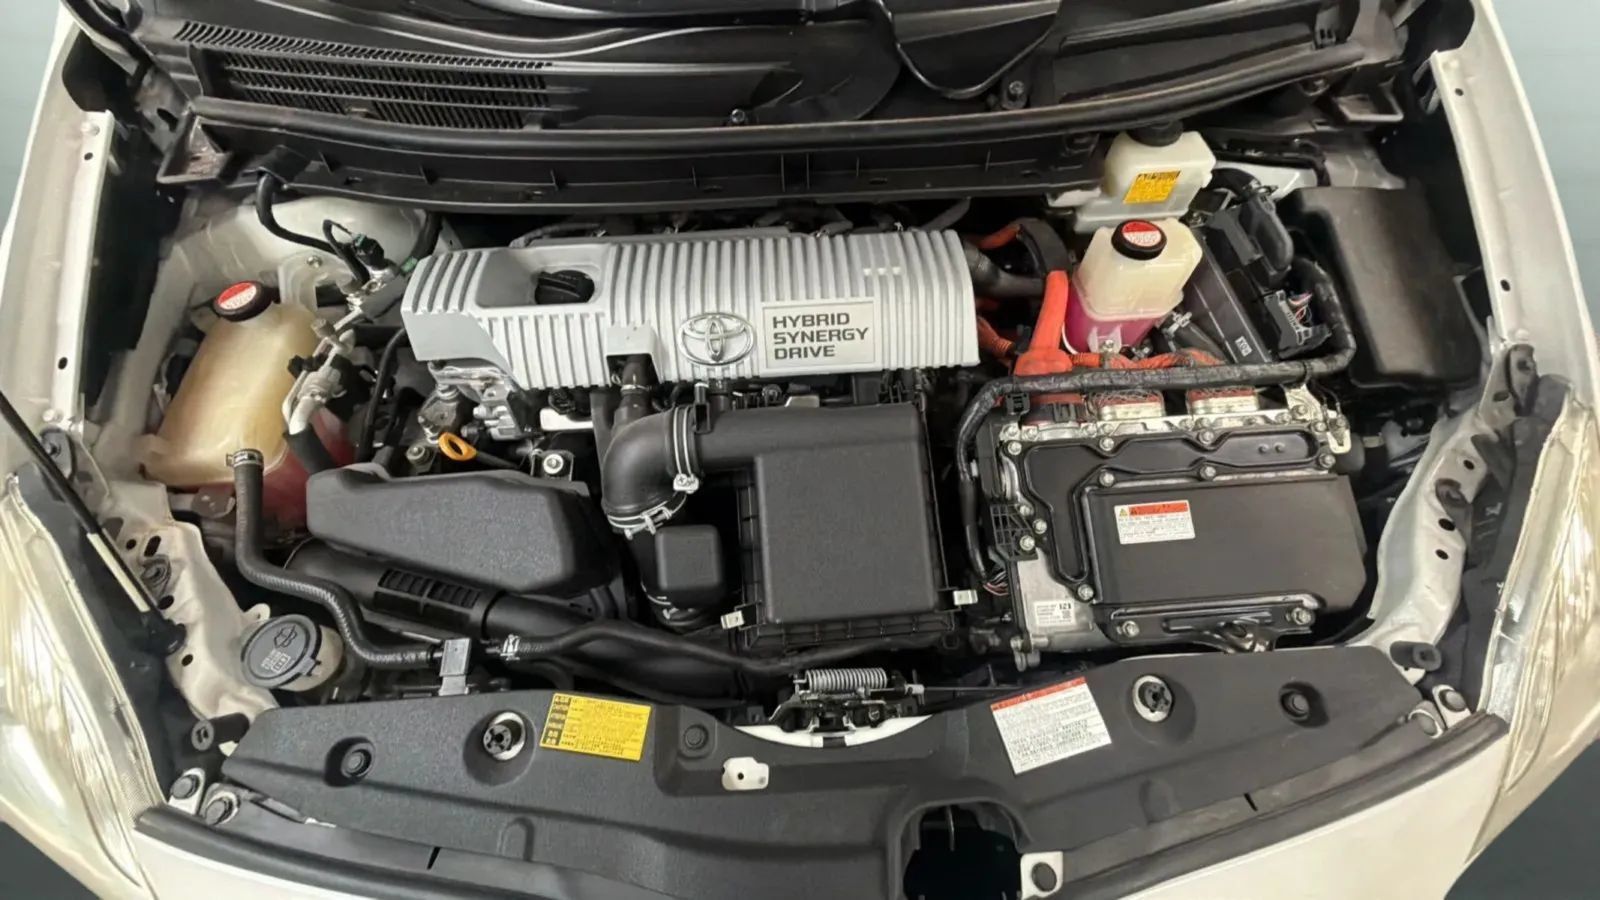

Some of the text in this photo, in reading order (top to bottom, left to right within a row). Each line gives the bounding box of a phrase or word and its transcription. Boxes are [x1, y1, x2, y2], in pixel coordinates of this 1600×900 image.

[772, 312, 850, 329] HYBRID
[773, 327, 869, 345] SYNERGY
[774, 345, 836, 360] DRIVE
